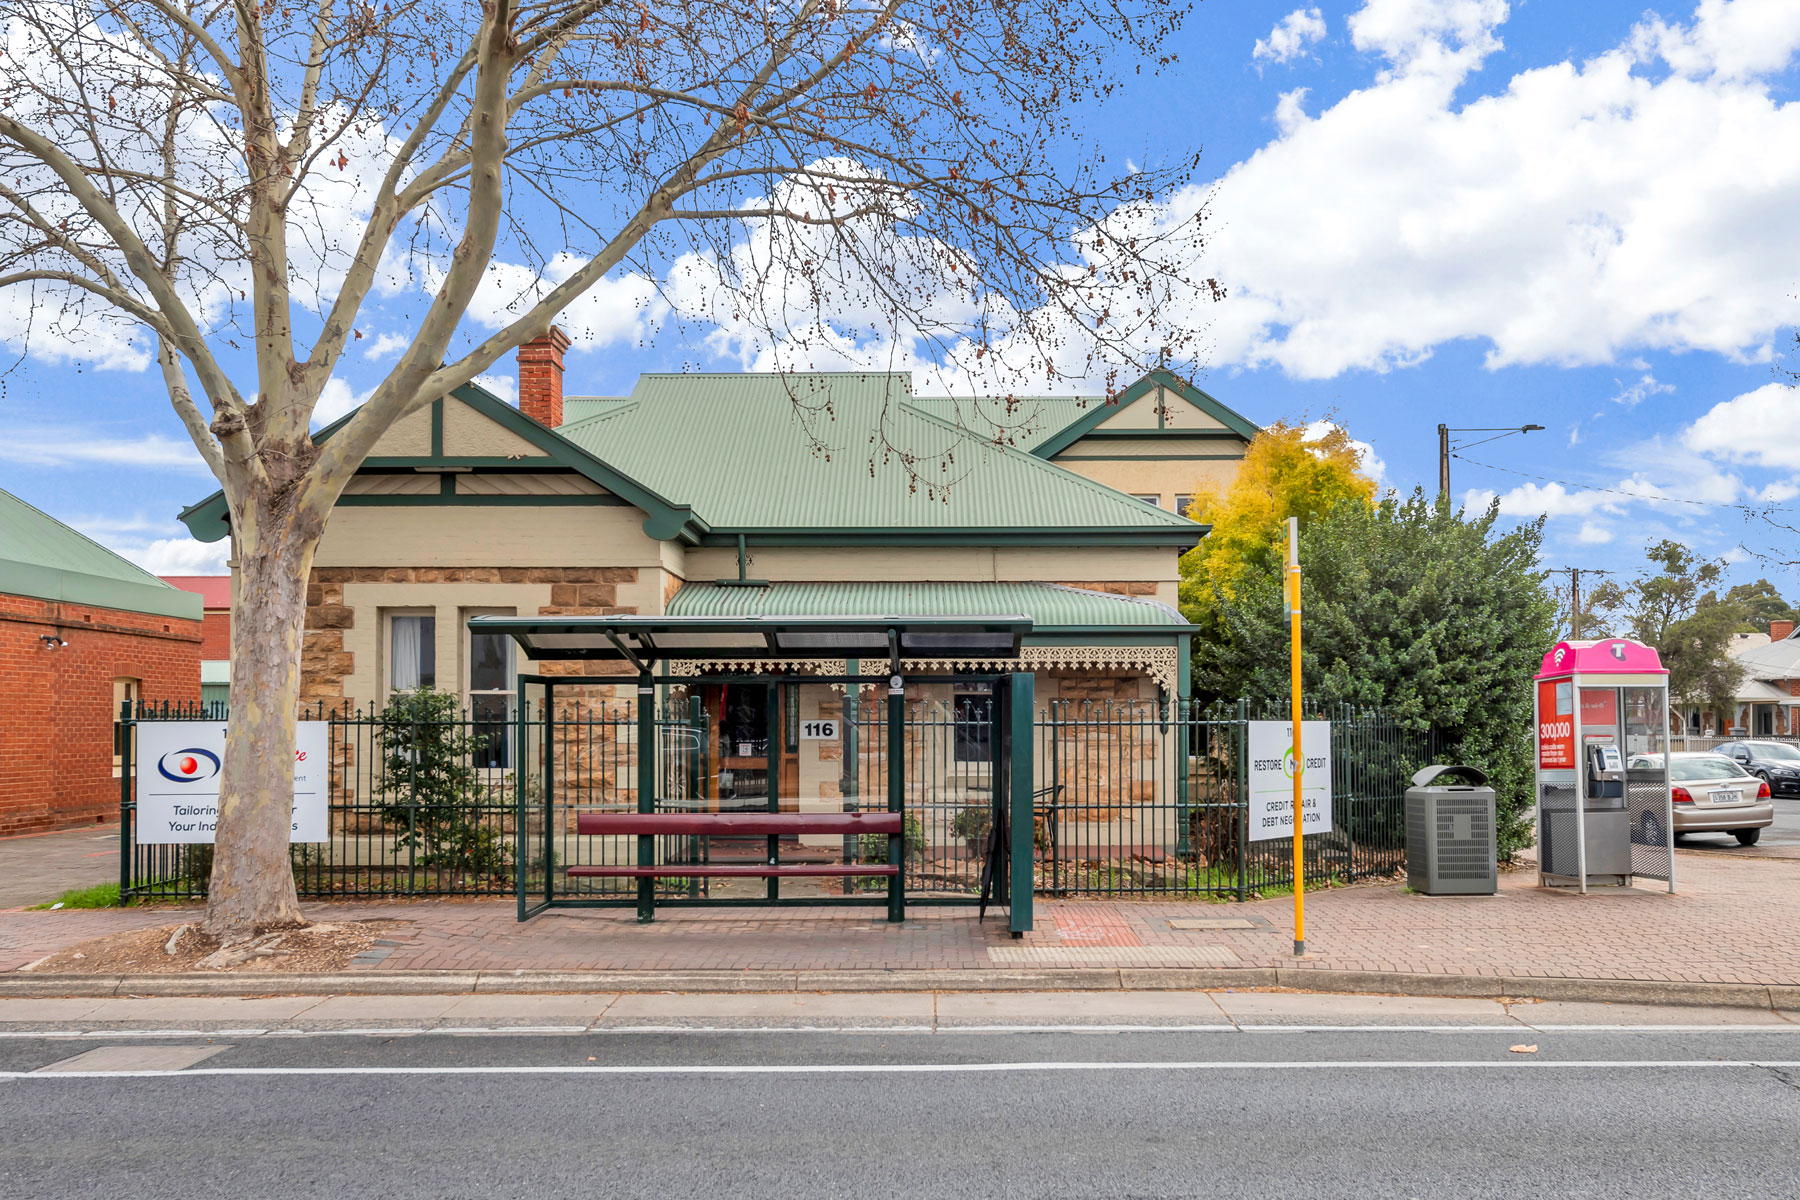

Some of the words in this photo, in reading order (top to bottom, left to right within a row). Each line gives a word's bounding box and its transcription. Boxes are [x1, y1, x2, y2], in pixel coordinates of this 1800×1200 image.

[1611, 643, 1626, 658] T
[804, 723, 834, 737] 116
[1540, 721, 1571, 741] 300,000
[1254, 759, 1282, 771] RESTORE
[1306, 757, 1326, 769] CREDIT
[1266, 800, 1288, 812] CREDIT
[1290, 799, 1311, 810] RAIR
[1312, 798, 1317, 807] &
[168, 821, 198, 832] Your
[1262, 816, 1278, 828] DEBT
